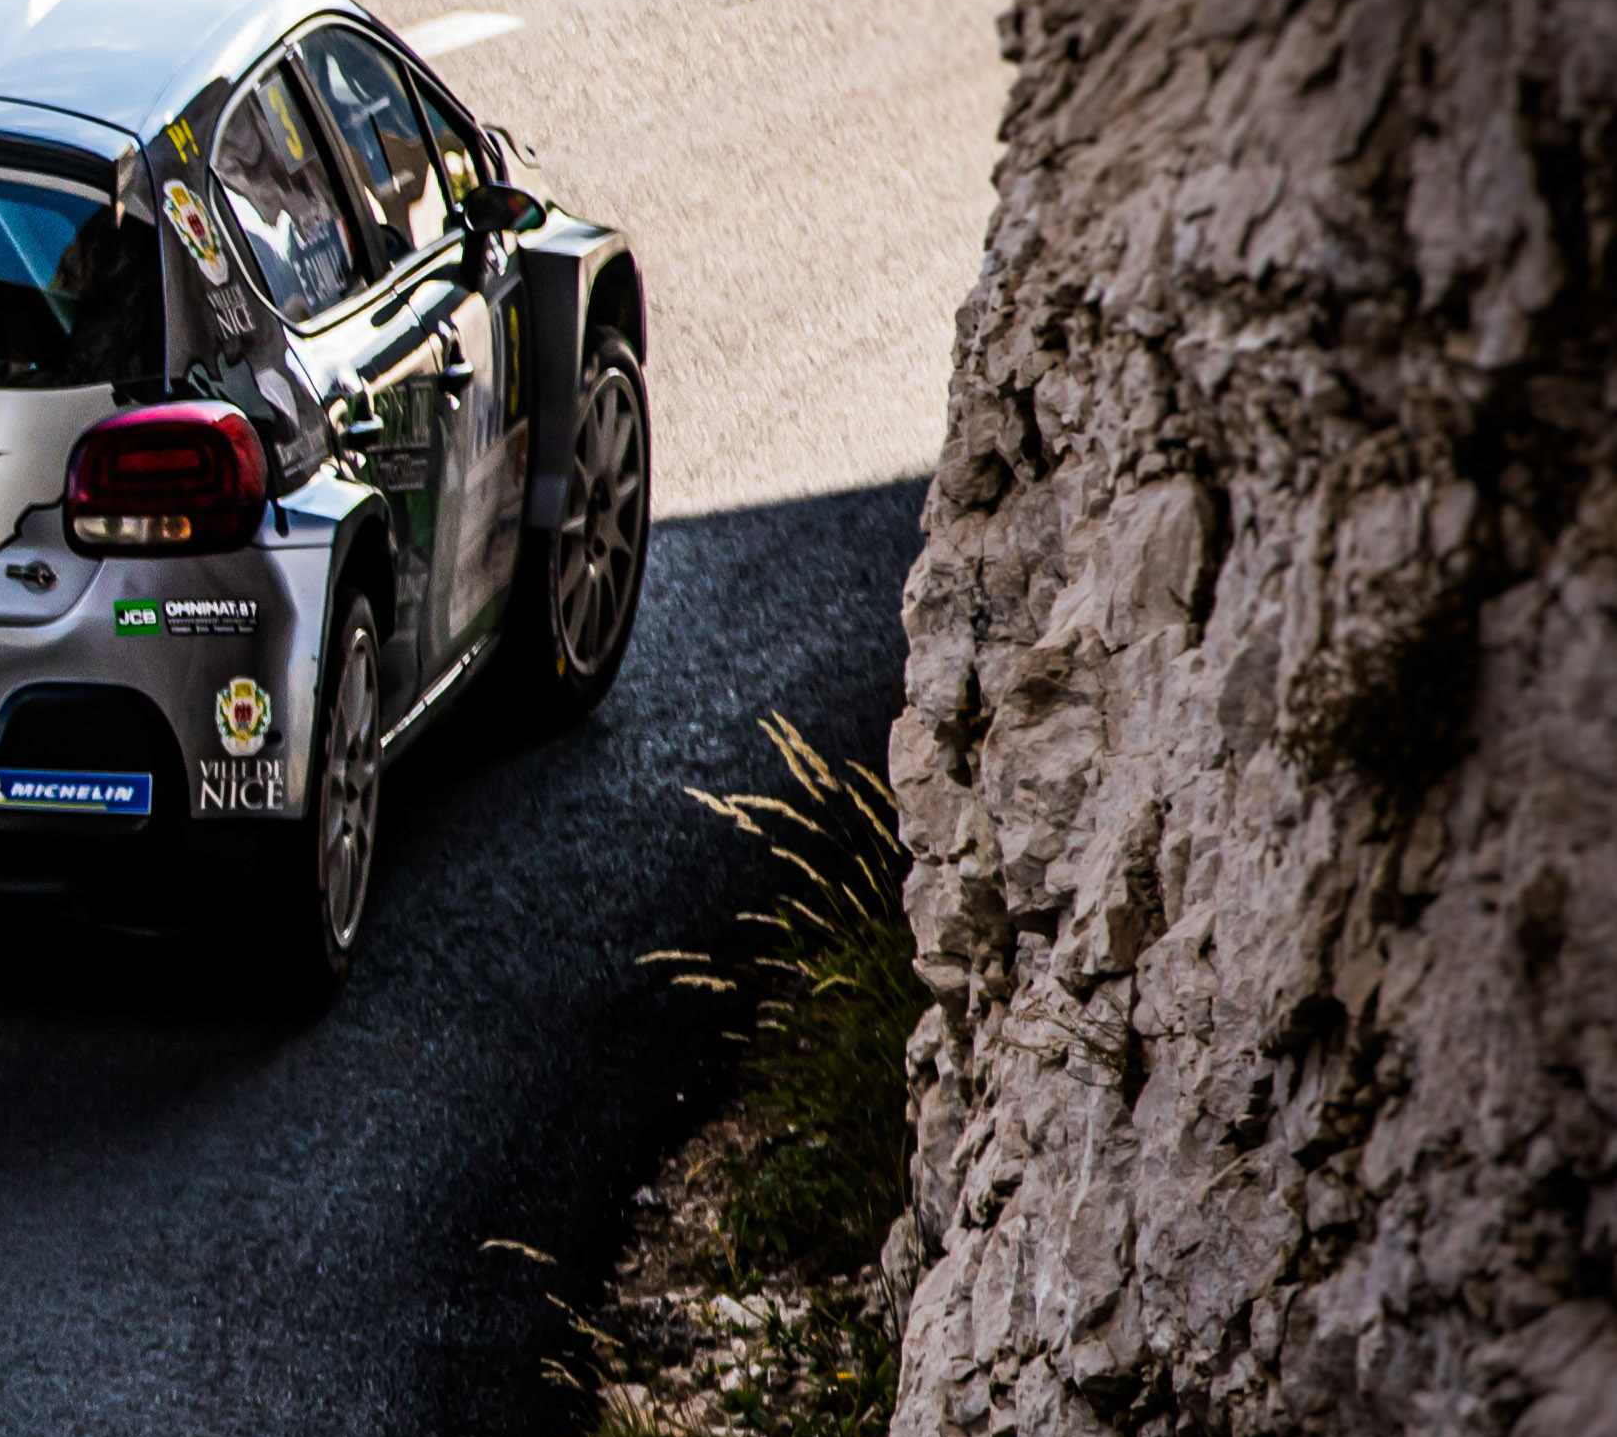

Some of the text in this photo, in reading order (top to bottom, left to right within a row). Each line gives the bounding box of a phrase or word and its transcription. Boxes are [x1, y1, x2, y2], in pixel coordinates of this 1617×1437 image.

[268, 86, 304, 161] 3
[118, 609, 157, 626] JCB
[10, 781, 135, 802] MICHELIN
[200, 779, 284, 810] NICE
